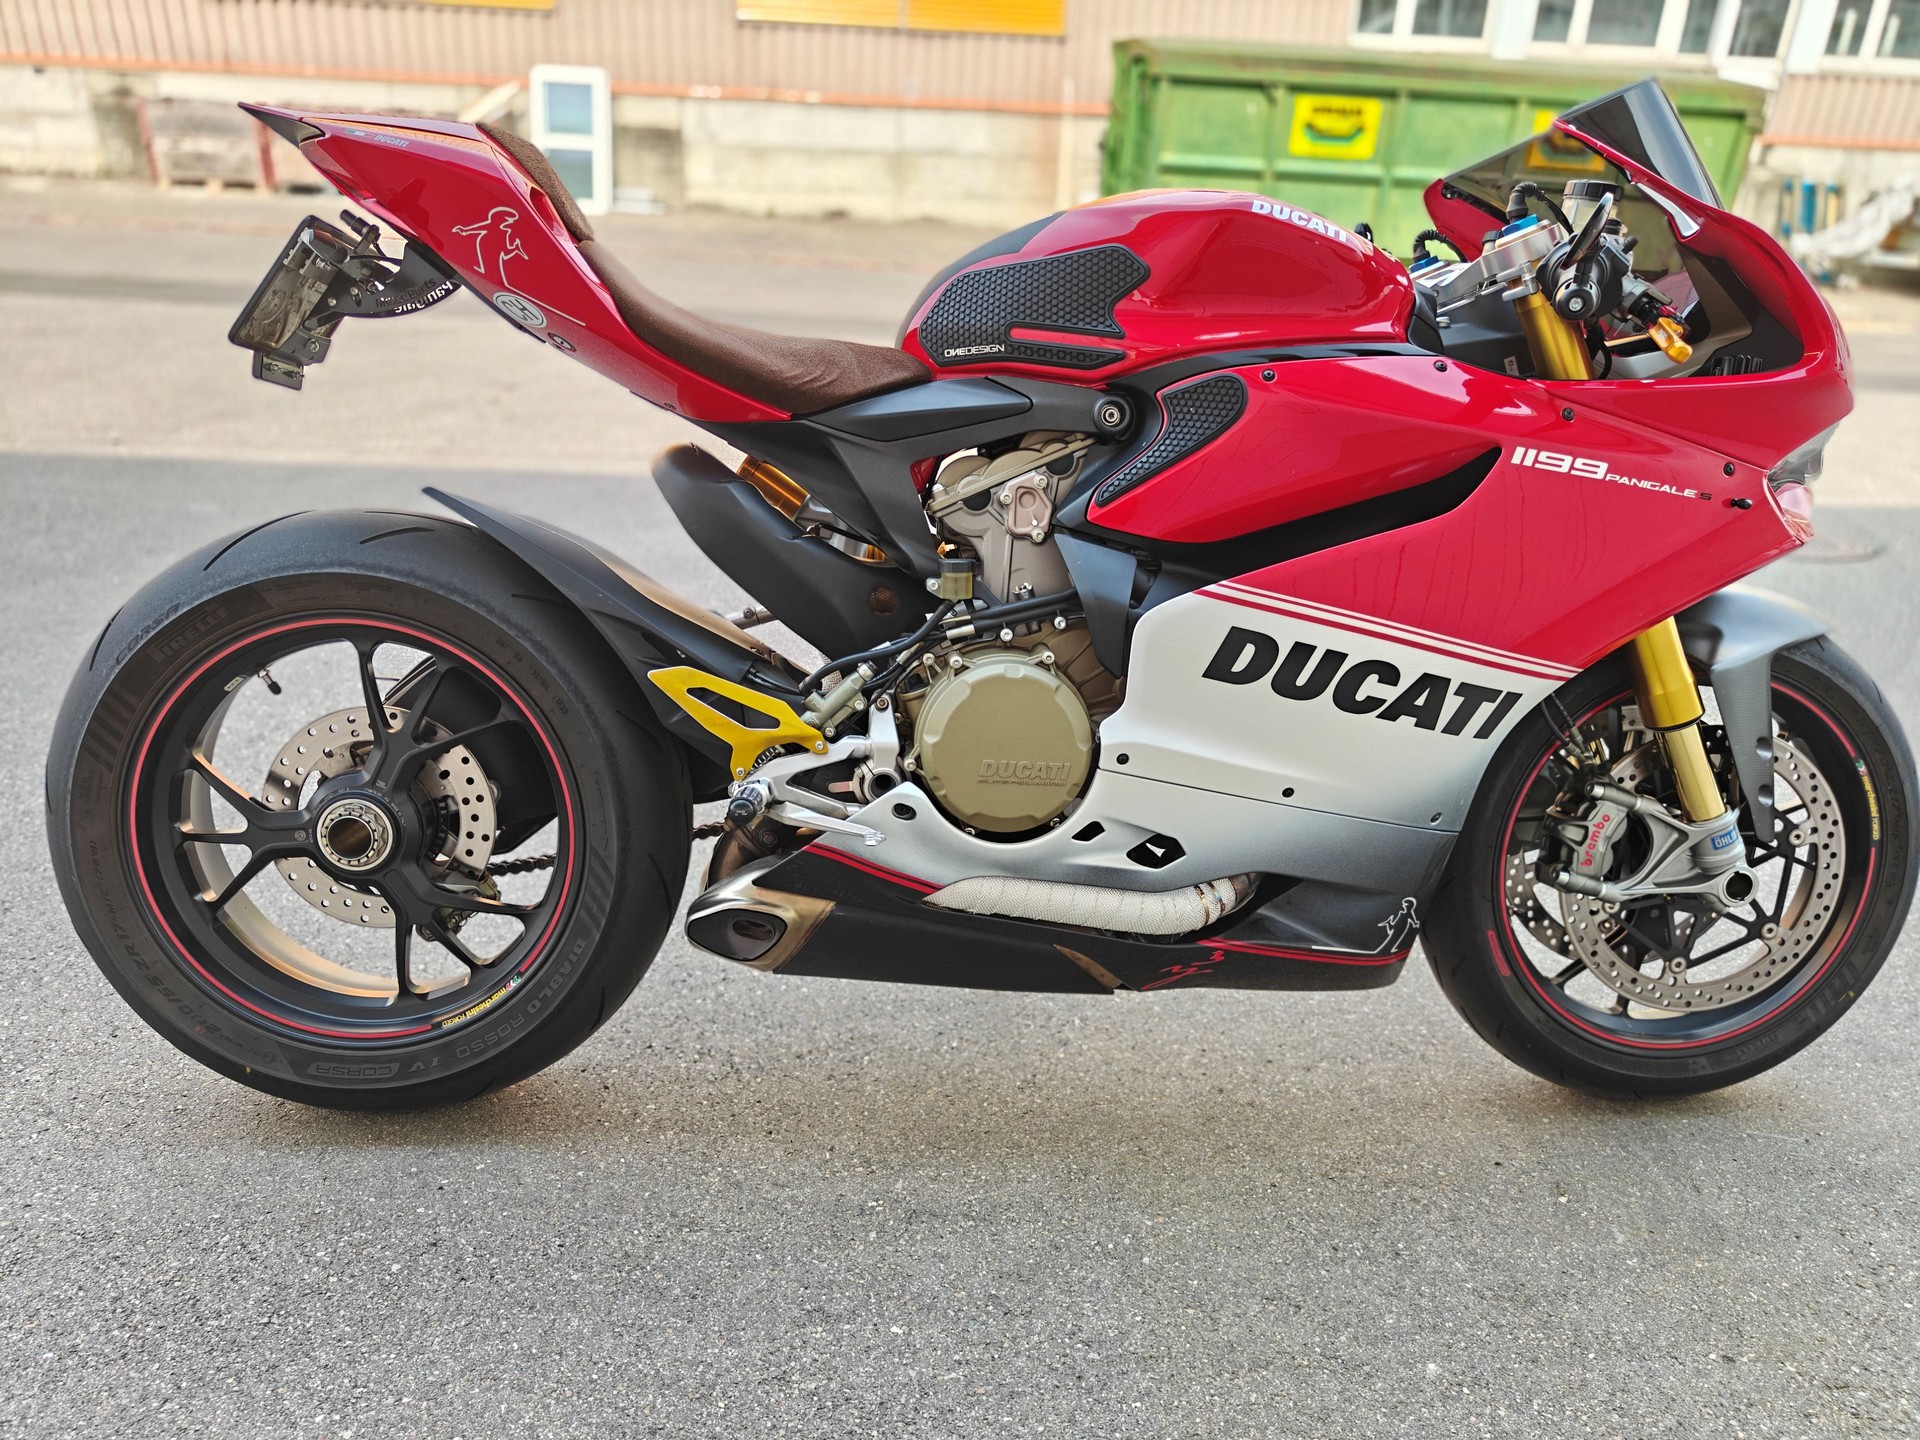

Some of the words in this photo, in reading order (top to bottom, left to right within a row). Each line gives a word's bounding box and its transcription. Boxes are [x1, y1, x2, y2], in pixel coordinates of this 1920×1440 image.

[374, 135, 410, 148] DUCATI
[1251, 199, 1348, 243] DUCATI
[944, 344, 1005, 357] ONEDESIGN
[1510, 446, 1608, 480] 1199
[1604, 473, 1697, 499] PANIGALE
[1698, 491, 1713, 501] S
[147, 604, 228, 663] PIRELLI
[1202, 626, 1523, 739] DUCATI
[979, 759, 1071, 781] DUCATI
[1861, 775, 1879, 818] marchesini
[1580, 813, 1611, 868] brembo
[526, 937, 588, 1015] DIABLO
[441, 1012, 466, 1028] FORGED
[465, 987, 507, 1018] marchesini
[456, 1013, 525, 1059] ROSSO
[315, 1063, 392, 1078] CORSA
[407, 1056, 442, 1074] IV
